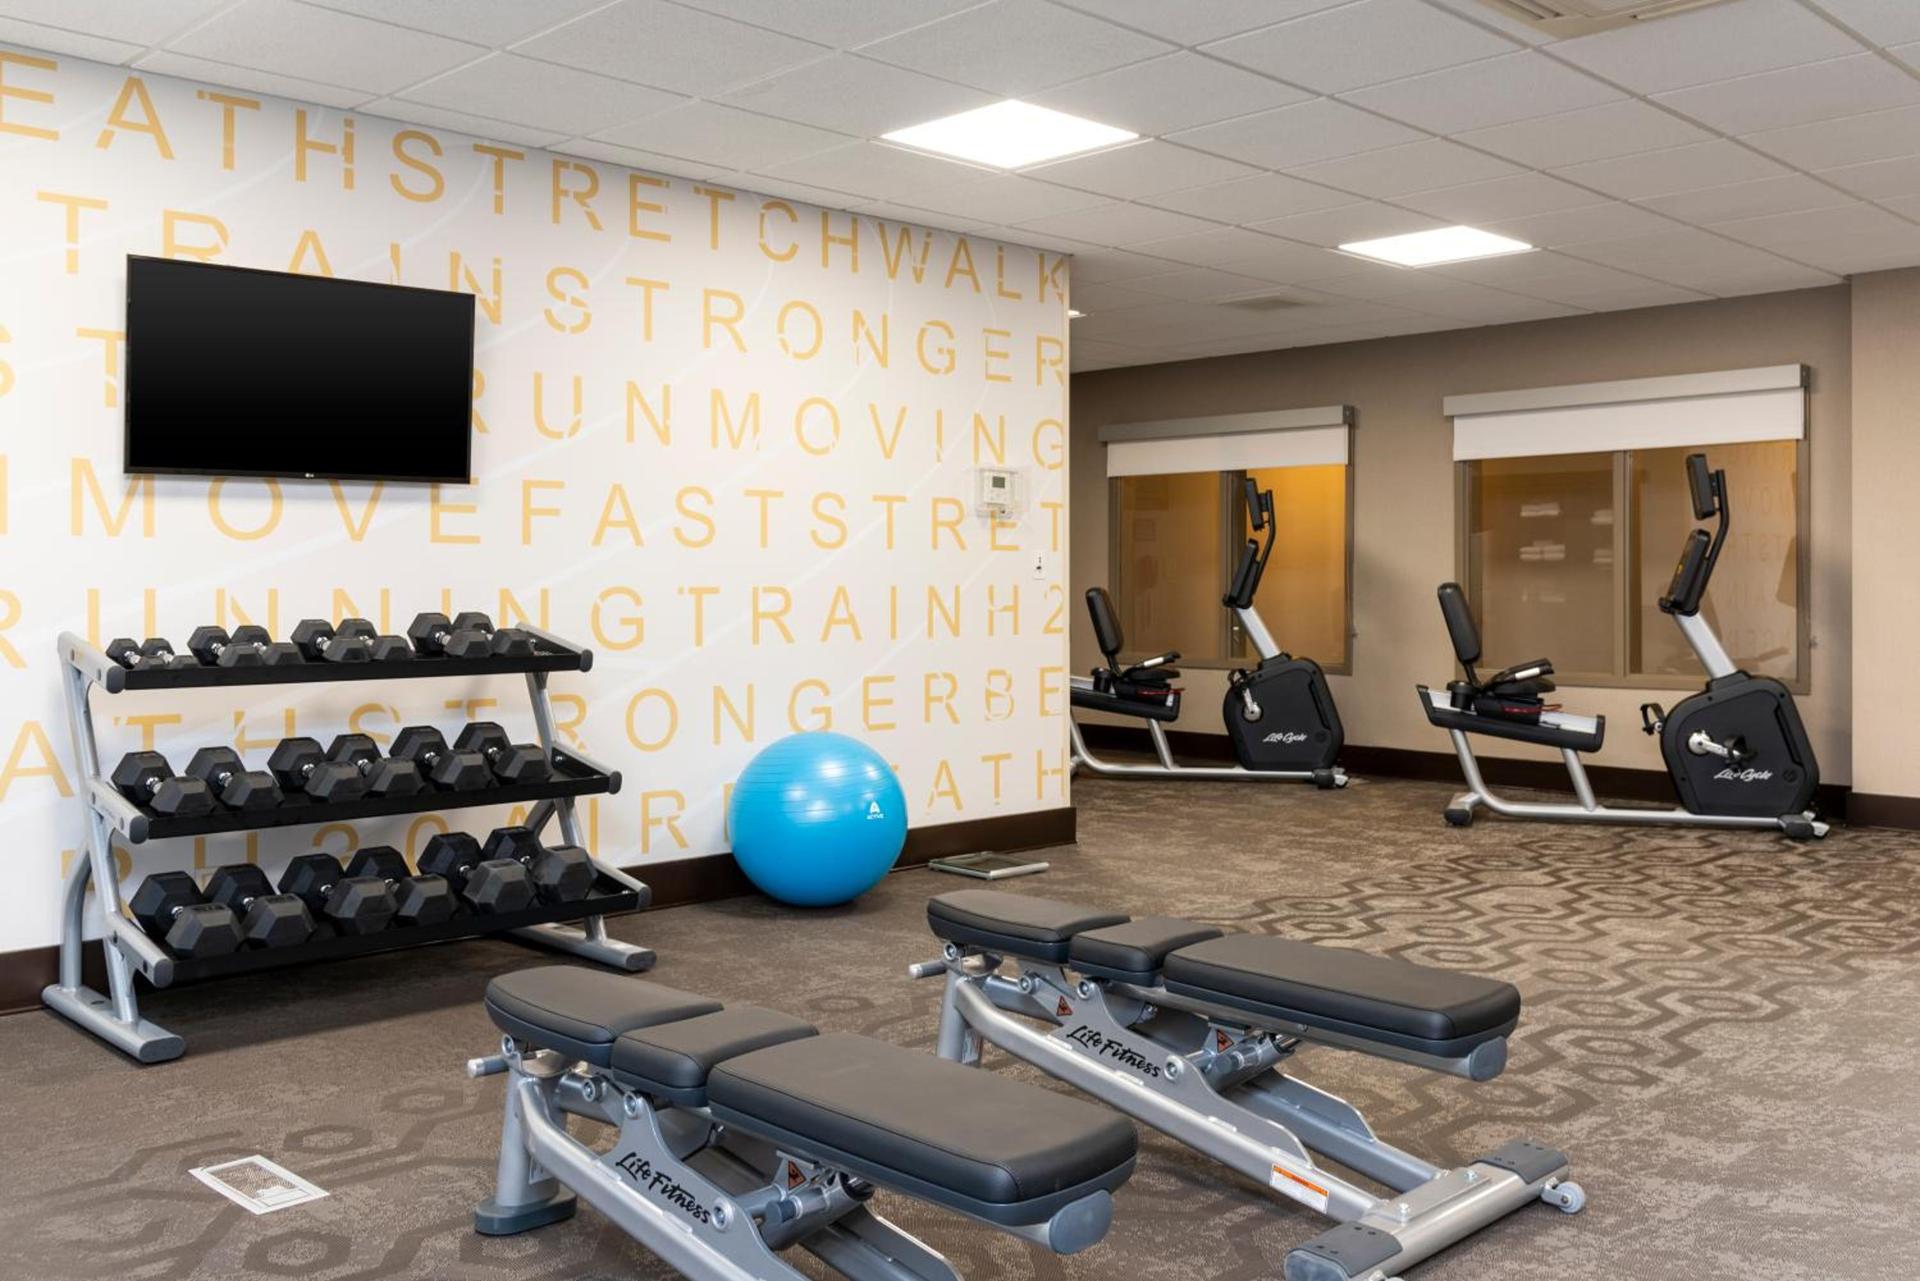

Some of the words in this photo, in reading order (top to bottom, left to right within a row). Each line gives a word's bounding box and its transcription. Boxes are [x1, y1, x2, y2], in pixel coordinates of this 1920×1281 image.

[1066, 1025, 1102, 1049] Life
[1099, 1038, 1160, 1078] Fitness
[615, 1151, 652, 1182] Life
[648, 1170, 711, 1224] Fitness
